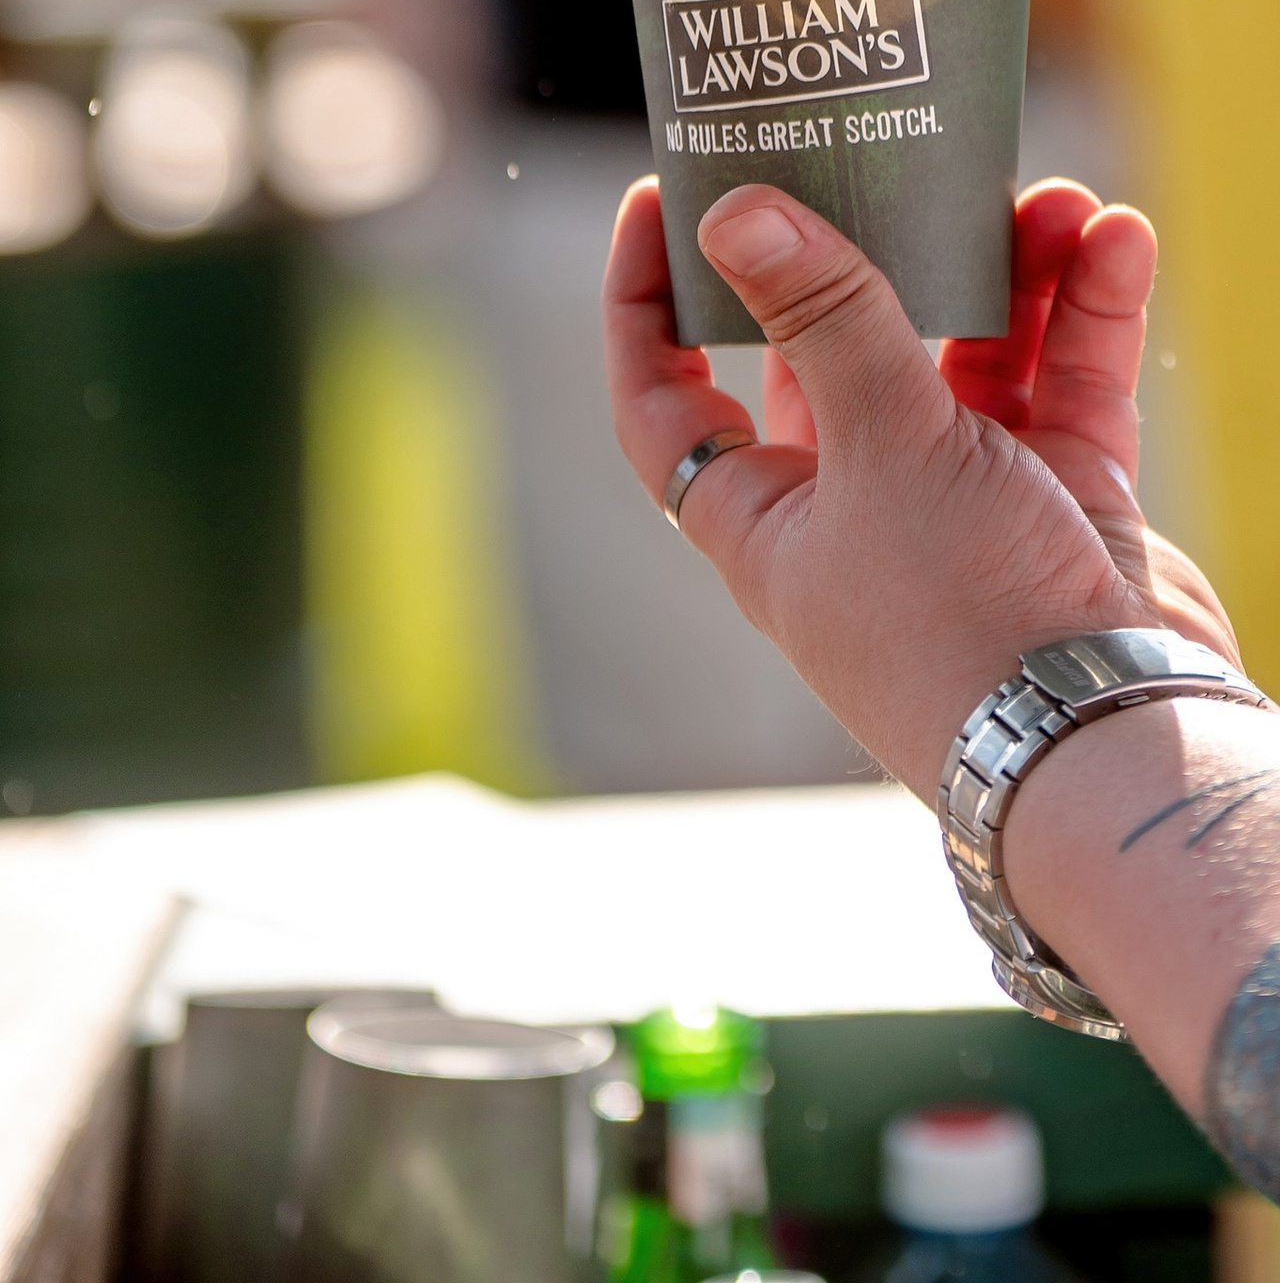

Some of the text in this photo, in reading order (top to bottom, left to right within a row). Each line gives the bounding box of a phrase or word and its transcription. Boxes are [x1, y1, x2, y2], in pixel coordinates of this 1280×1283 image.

[679, 30, 905, 97] LAWSON'S
[666, 105, 944, 154] NO RULES. GREAT SCOTCH.
